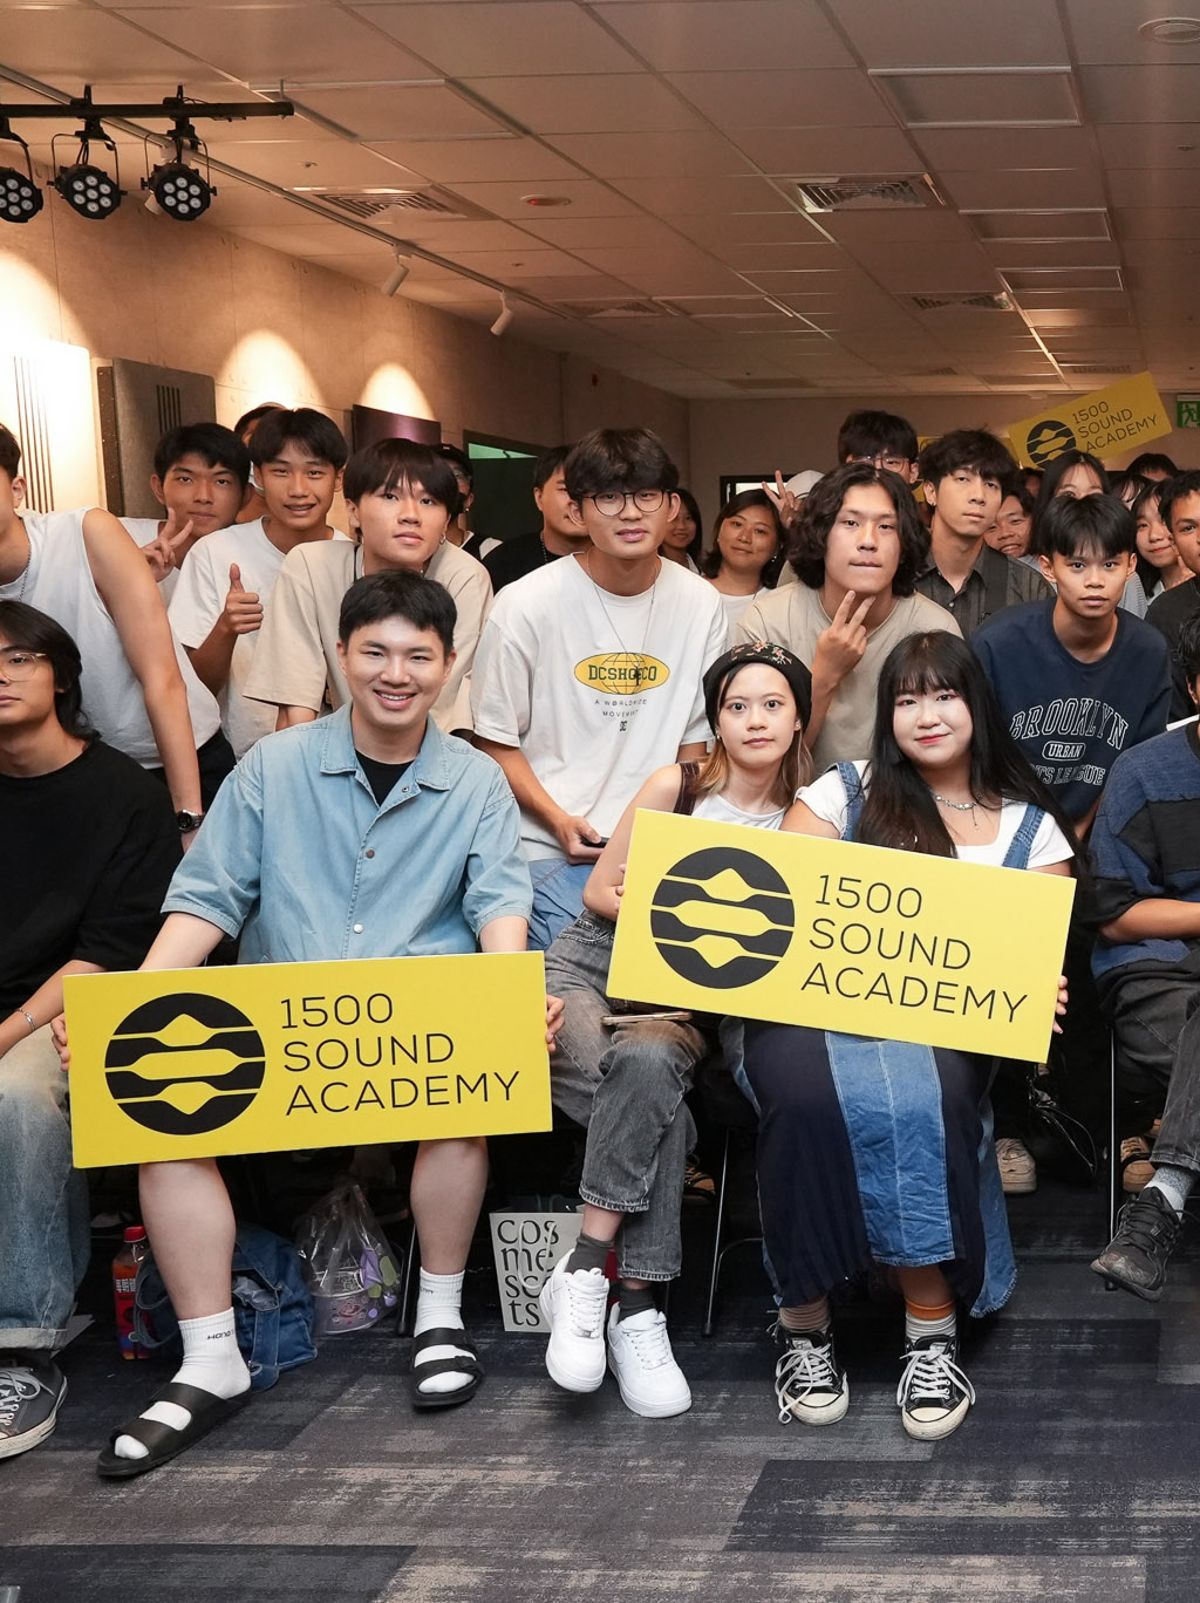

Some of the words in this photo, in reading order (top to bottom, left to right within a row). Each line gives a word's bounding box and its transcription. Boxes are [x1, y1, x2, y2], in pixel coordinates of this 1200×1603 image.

[1072, 401, 1109, 424] 1500
[1078, 408, 1133, 439] SOUND
[1086, 414, 1158, 452] ACADEMY
[1009, 697, 1129, 750] BROOKLYN
[1048, 743, 1083, 758] URBAN
[815, 874, 922, 918] 1500
[809, 918, 971, 970] SOUND
[280, 993, 393, 1029] 1500
[800, 962, 1028, 1023] ACADEMY
[283, 1032, 454, 1072] SOUND
[286, 1070, 520, 1116] ACADEMY
